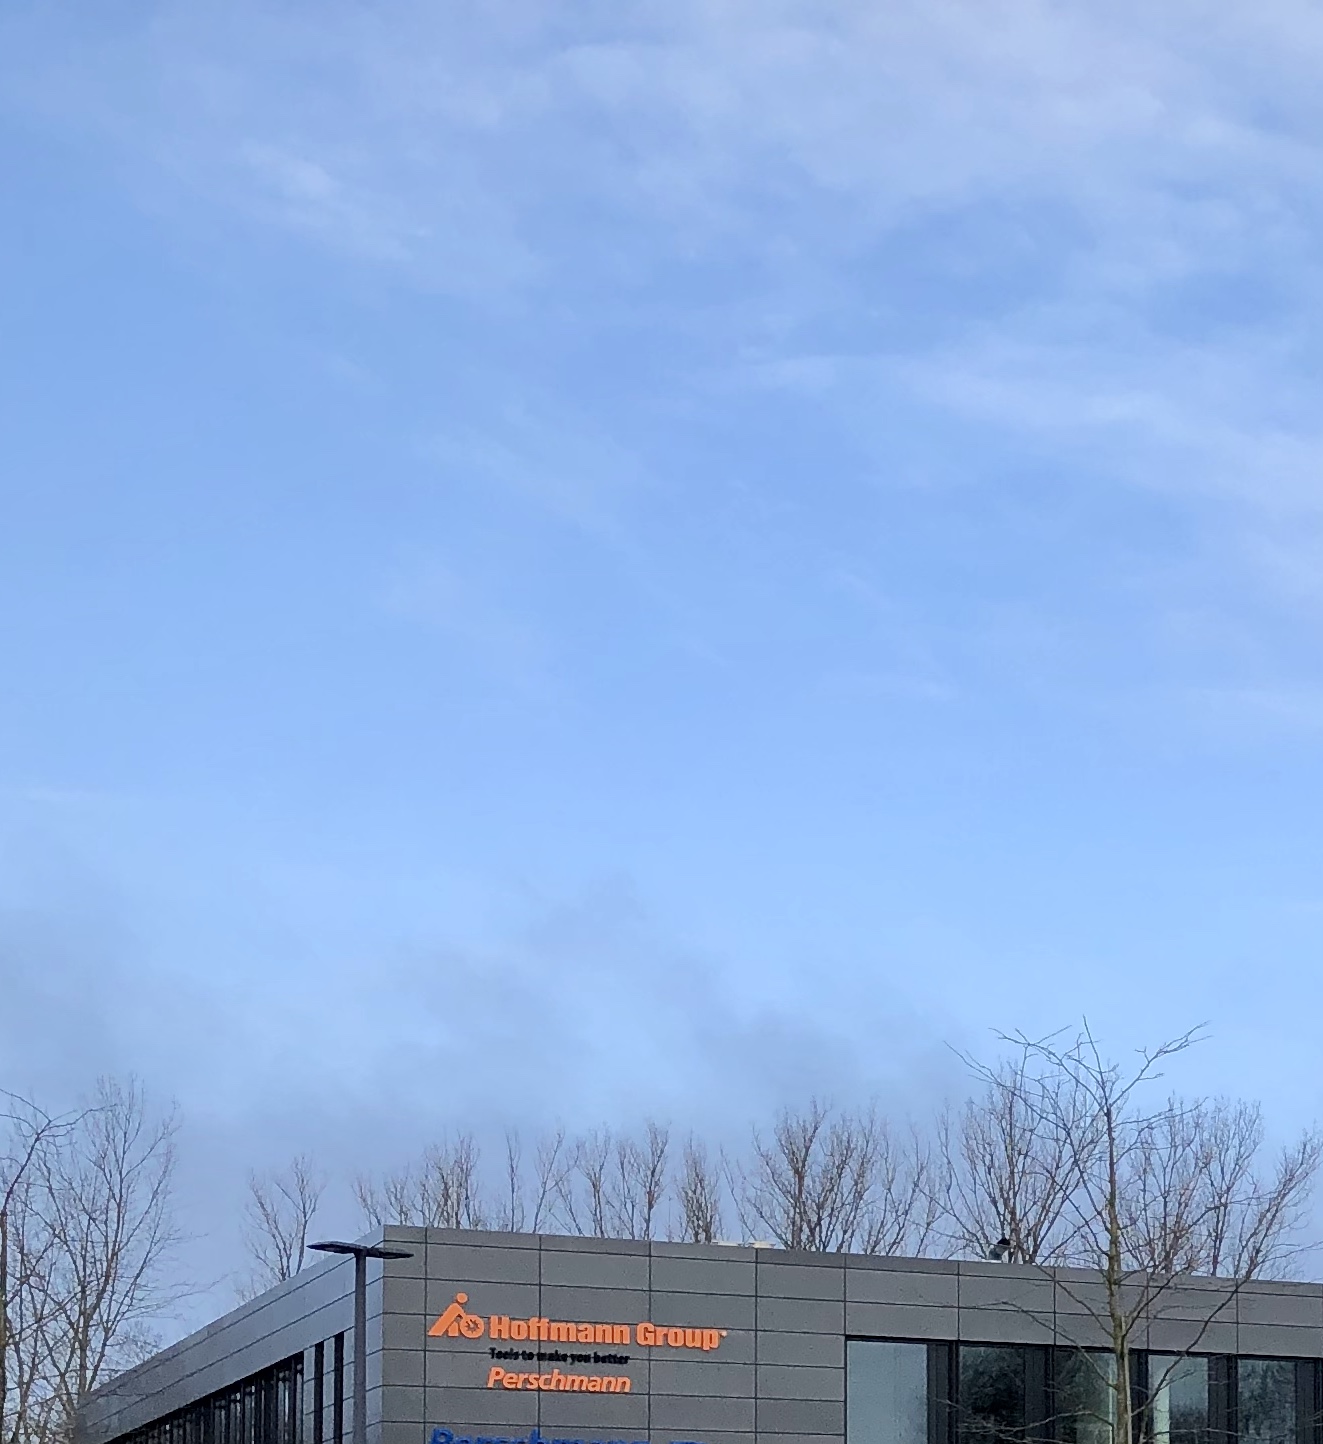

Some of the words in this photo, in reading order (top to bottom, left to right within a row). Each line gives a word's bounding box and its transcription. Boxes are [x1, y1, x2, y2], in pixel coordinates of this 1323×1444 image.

[490, 1315, 630, 1345] Hoffmann
[636, 1322, 721, 1351] Group
[521, 1350, 534, 1360] to
[487, 1366, 631, 1392] Perschmann
